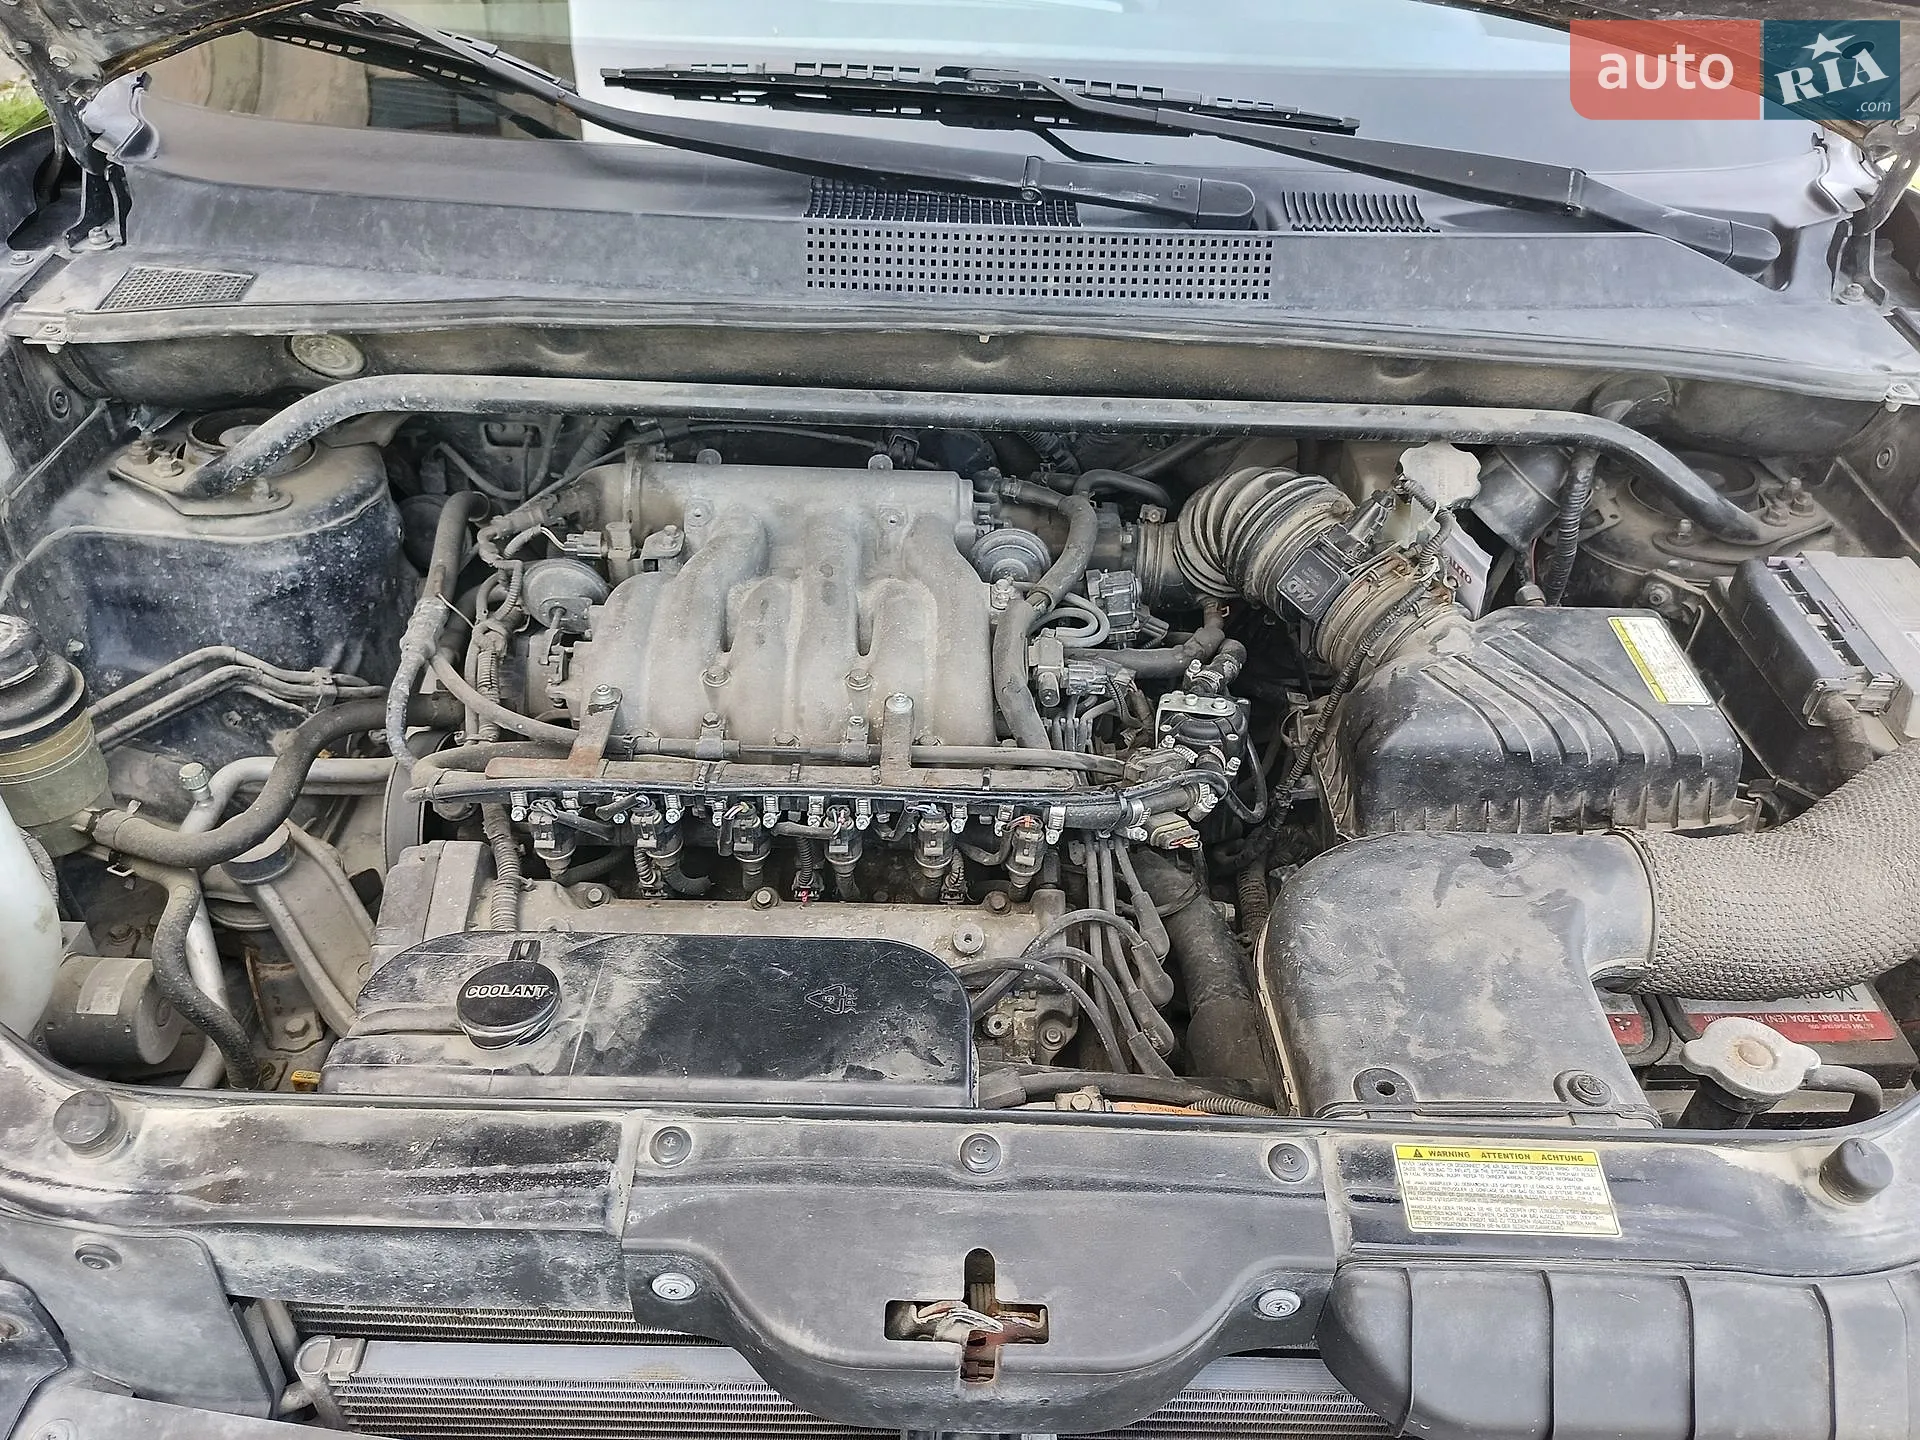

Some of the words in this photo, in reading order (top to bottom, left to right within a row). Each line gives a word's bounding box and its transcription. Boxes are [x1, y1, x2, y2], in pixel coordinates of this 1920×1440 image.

[465, 984, 549, 999] COOLANT
[1788, 1014, 1819, 1023] 750A
[1820, 1013, 1847, 1023] 78Ah
[1848, 1013, 1871, 1022] 12V
[1428, 1150, 1471, 1159] WARNING
[1481, 1152, 1531, 1160] ATTENTION
[1541, 1154, 1584, 1162] ACHTUNG
